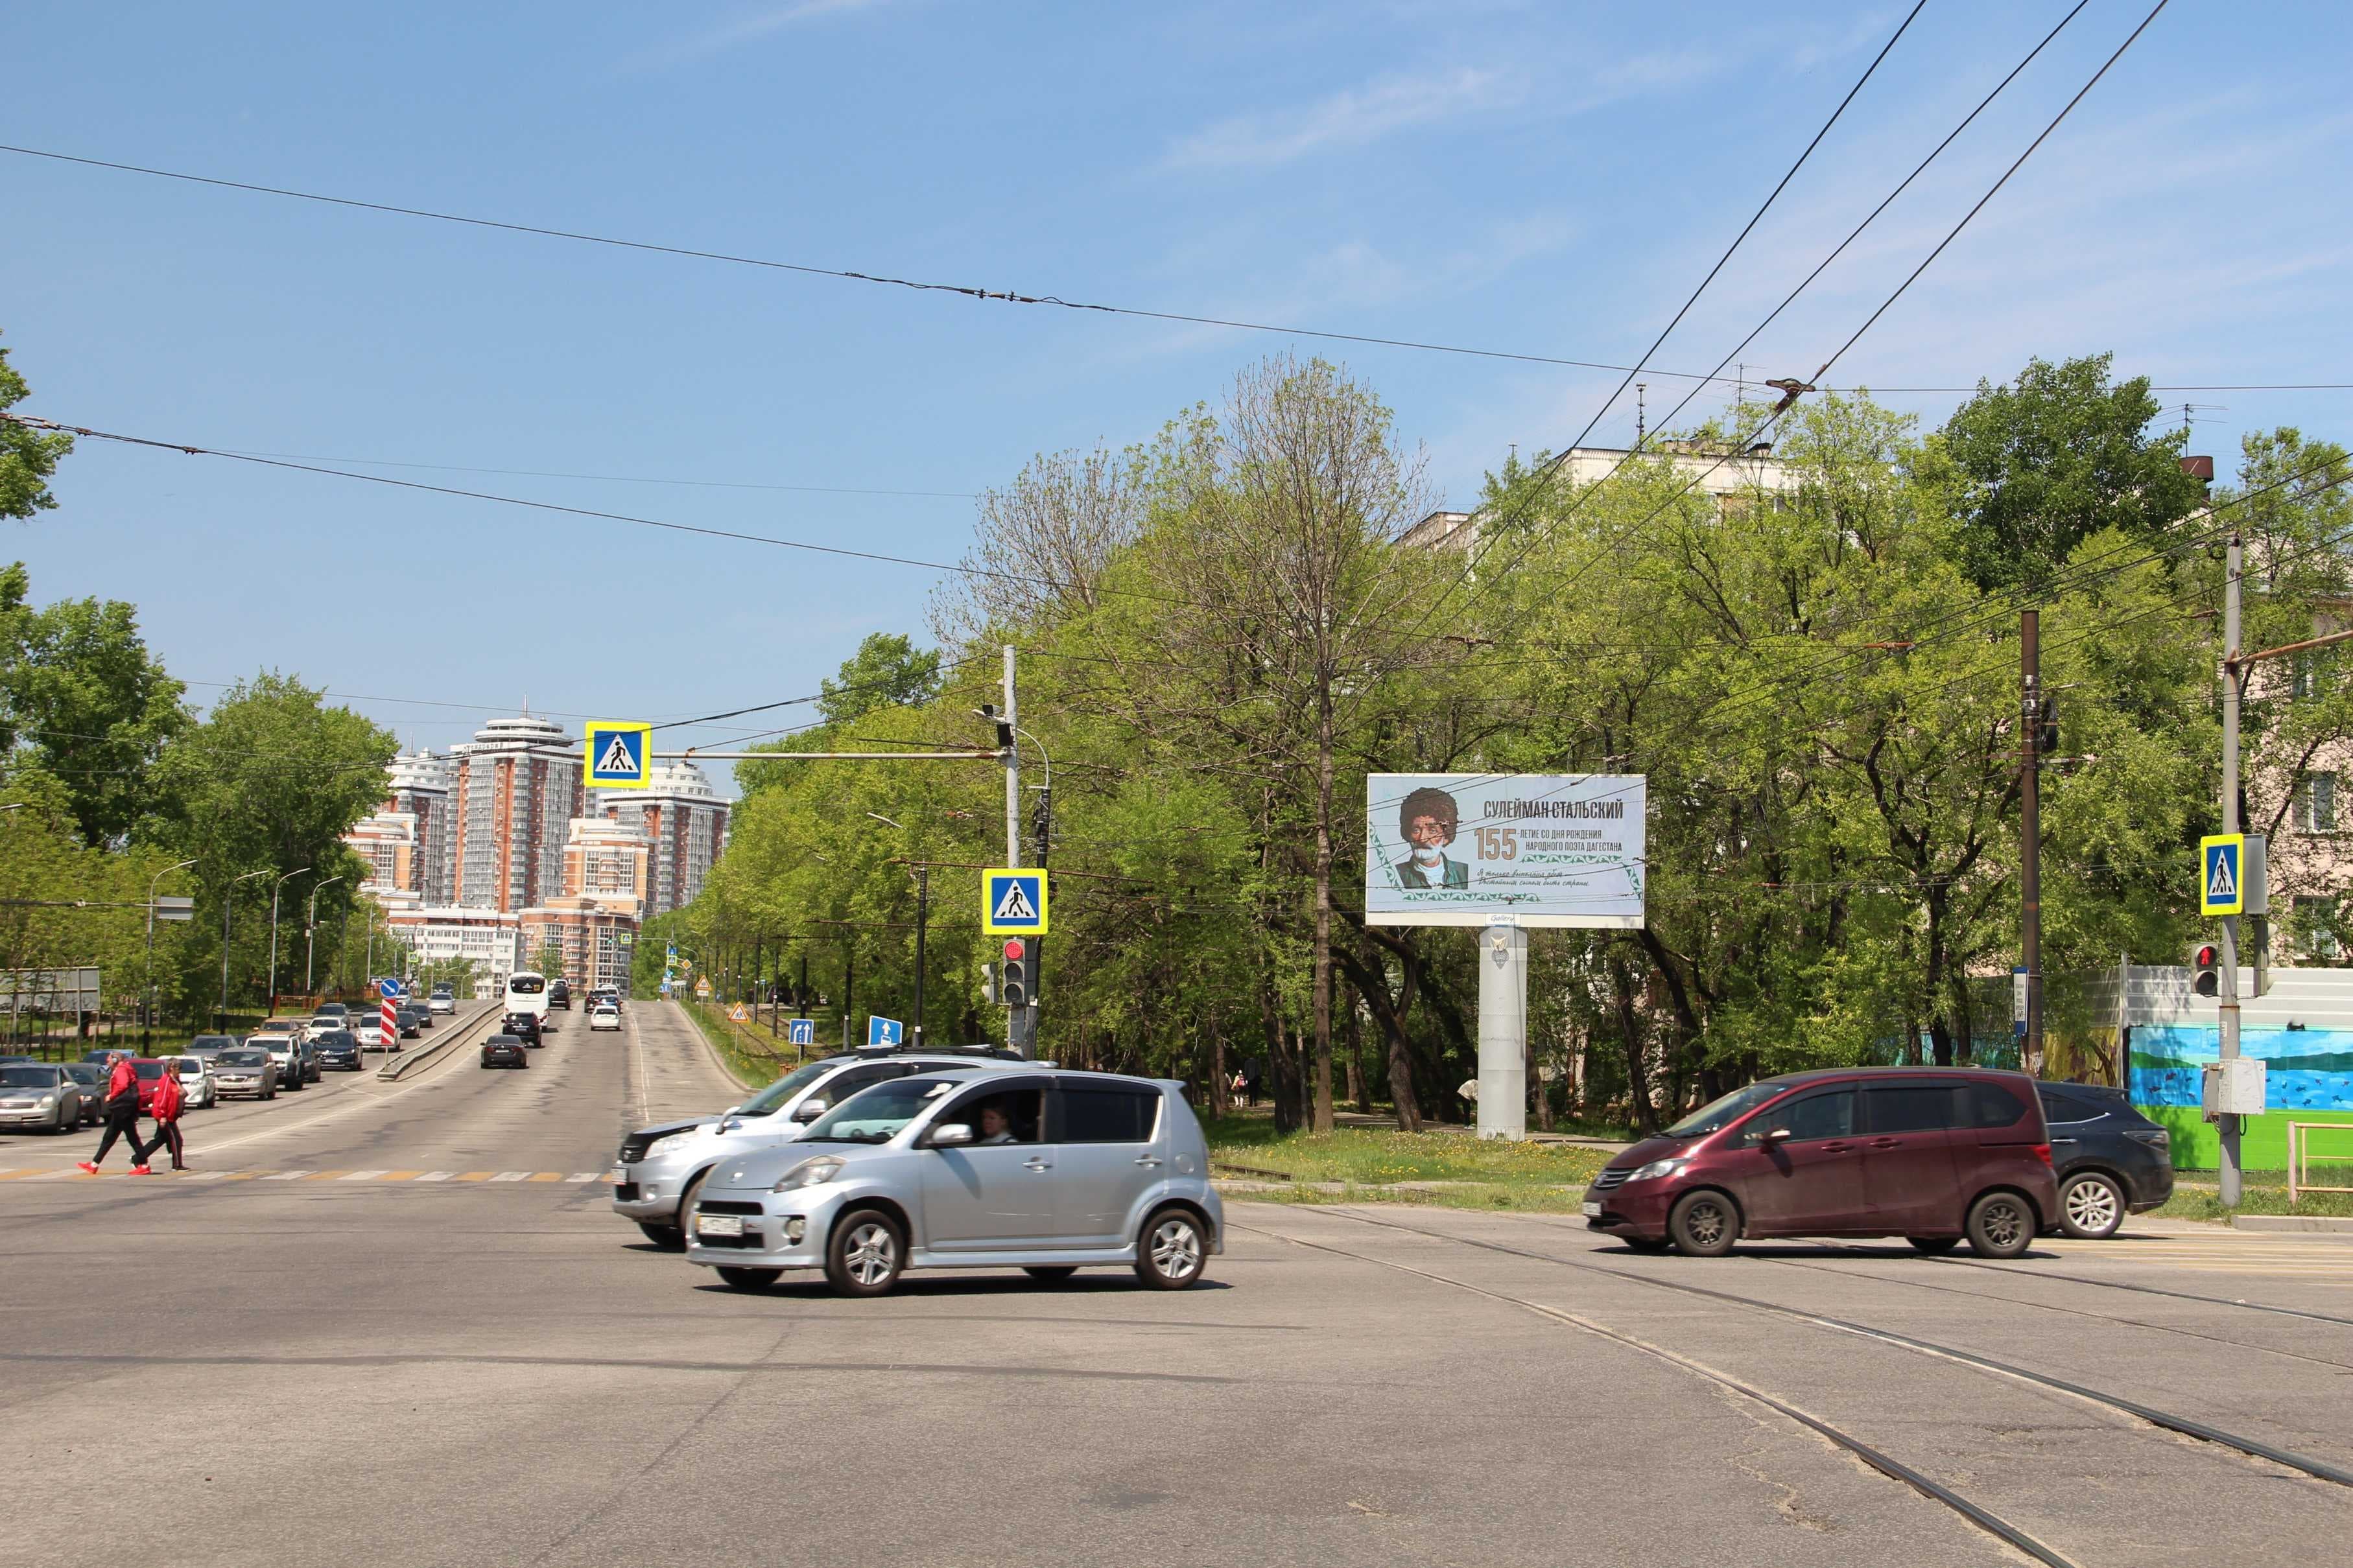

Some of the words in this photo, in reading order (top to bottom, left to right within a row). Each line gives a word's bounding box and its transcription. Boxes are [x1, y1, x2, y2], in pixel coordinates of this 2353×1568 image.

[1484, 798, 1549, 819] СУЛЕЙМАН
[1552, 799, 1624, 819] СТАЛЬСКИЙ
[1541, 830, 1550, 839] СО
[1552, 830, 1565, 840] ДНЯ
[1566, 830, 1602, 839] РОЖДЕНИЯ
[1474, 828, 1517, 860] 155
[1526, 841, 1563, 852] НАРОДНОГО
[1565, 841, 1585, 851] ПОЭТА
[1586, 842, 1622, 852] ДАГЕСТАНА
[1491, 915, 1515, 924] Gallery
